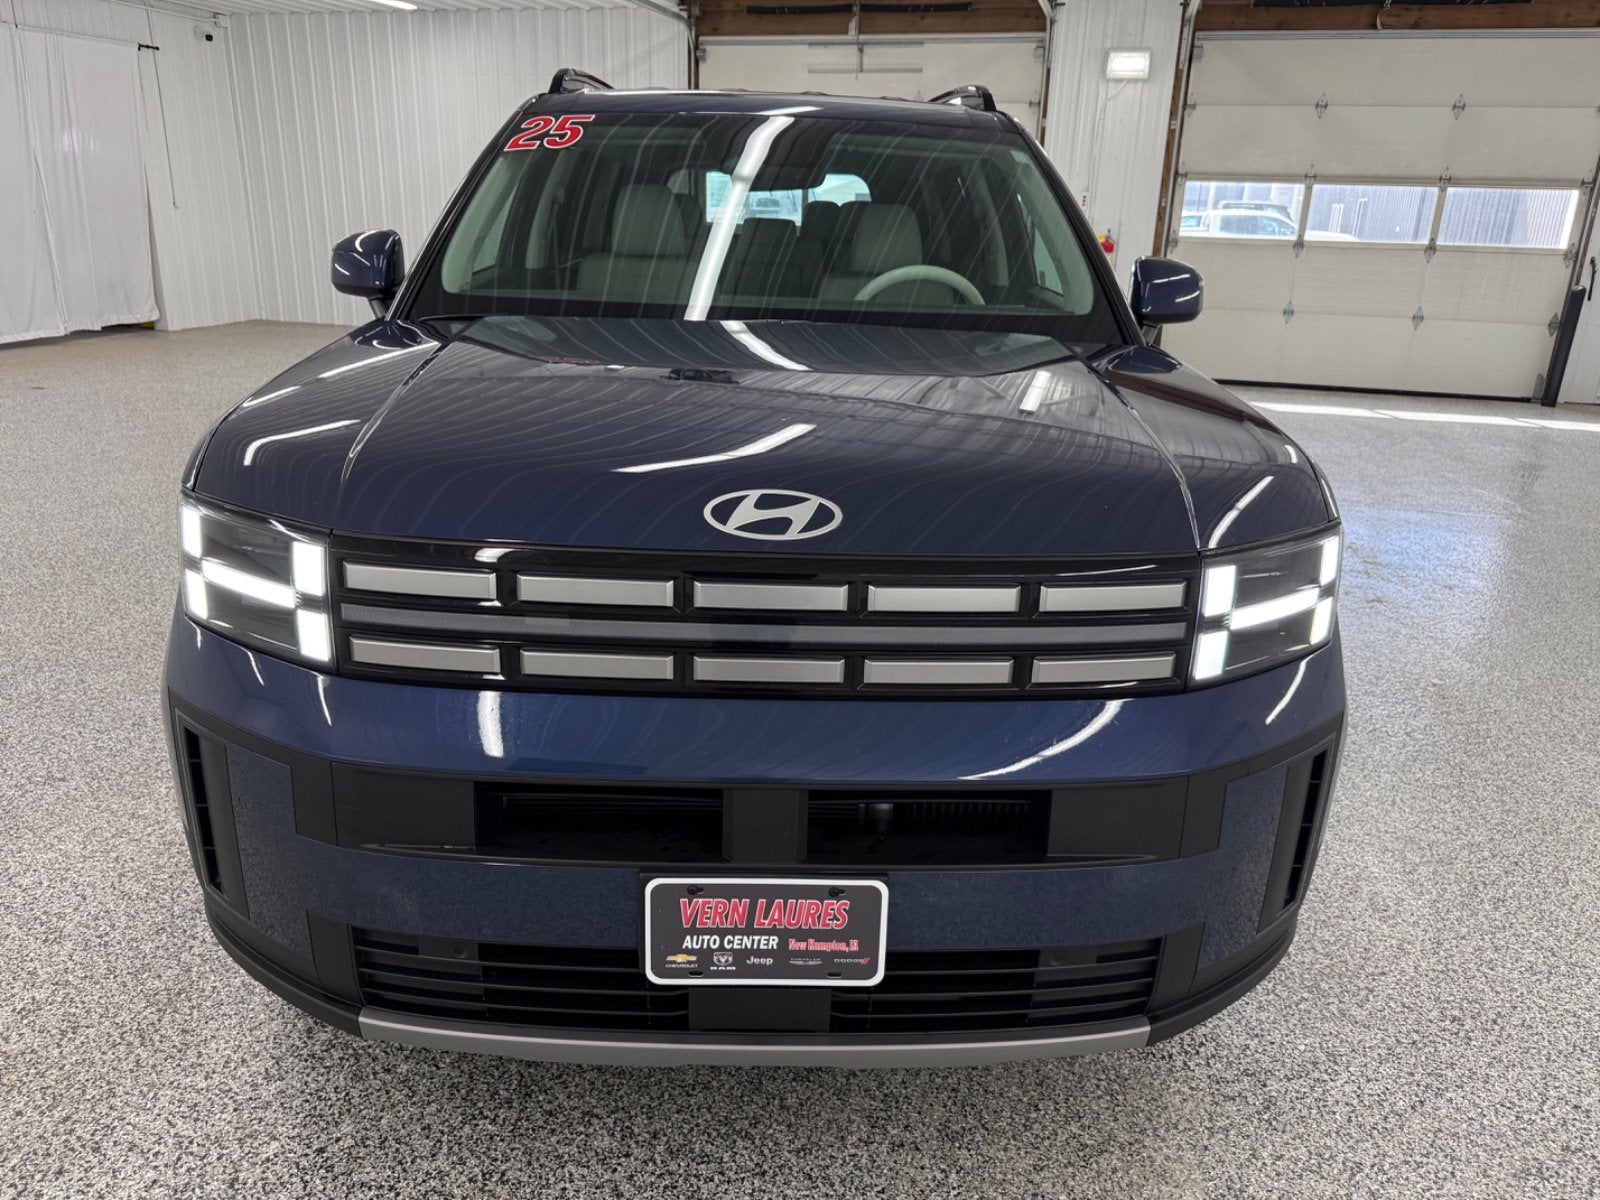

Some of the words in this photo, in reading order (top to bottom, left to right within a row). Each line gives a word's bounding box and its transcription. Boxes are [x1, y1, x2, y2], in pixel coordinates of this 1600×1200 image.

[503, 114, 595, 152] 25
[679, 898, 750, 928] VERN
[754, 898, 850, 929] LAURES
[682, 935, 720, 949] AUTO
[723, 935, 779, 949] CENTER
[789, 938, 807, 950] New
[746, 956, 773, 965] Jeep
